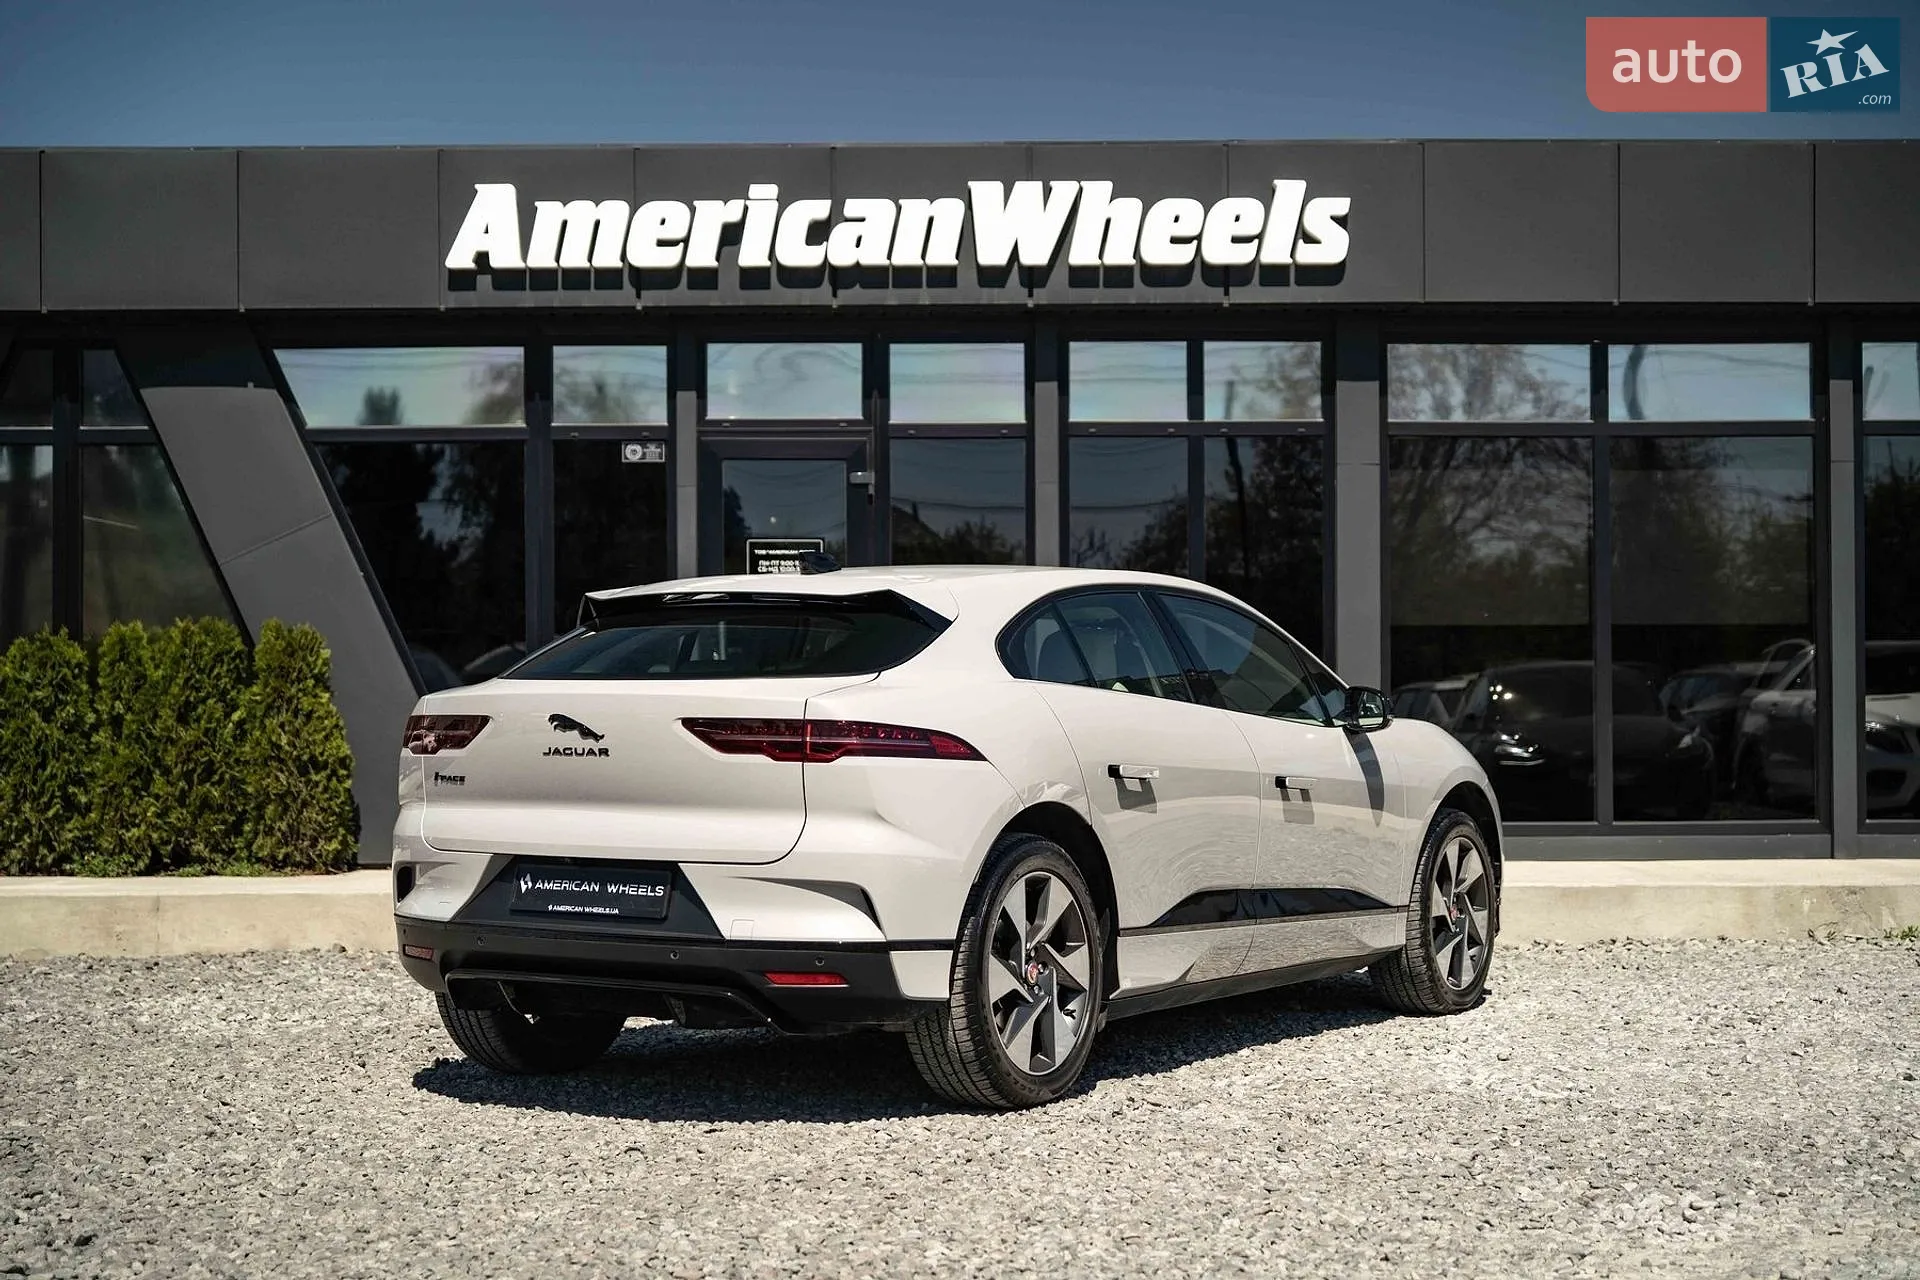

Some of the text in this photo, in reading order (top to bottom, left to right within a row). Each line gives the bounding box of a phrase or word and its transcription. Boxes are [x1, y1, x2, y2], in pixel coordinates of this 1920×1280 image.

[445, 179, 1352, 269] AmericanWheels
[542, 746, 610, 757] JAGUAR
[534, 879, 665, 897] AMERICAN WHEELS
[552, 905, 583, 913] AMERICAN
